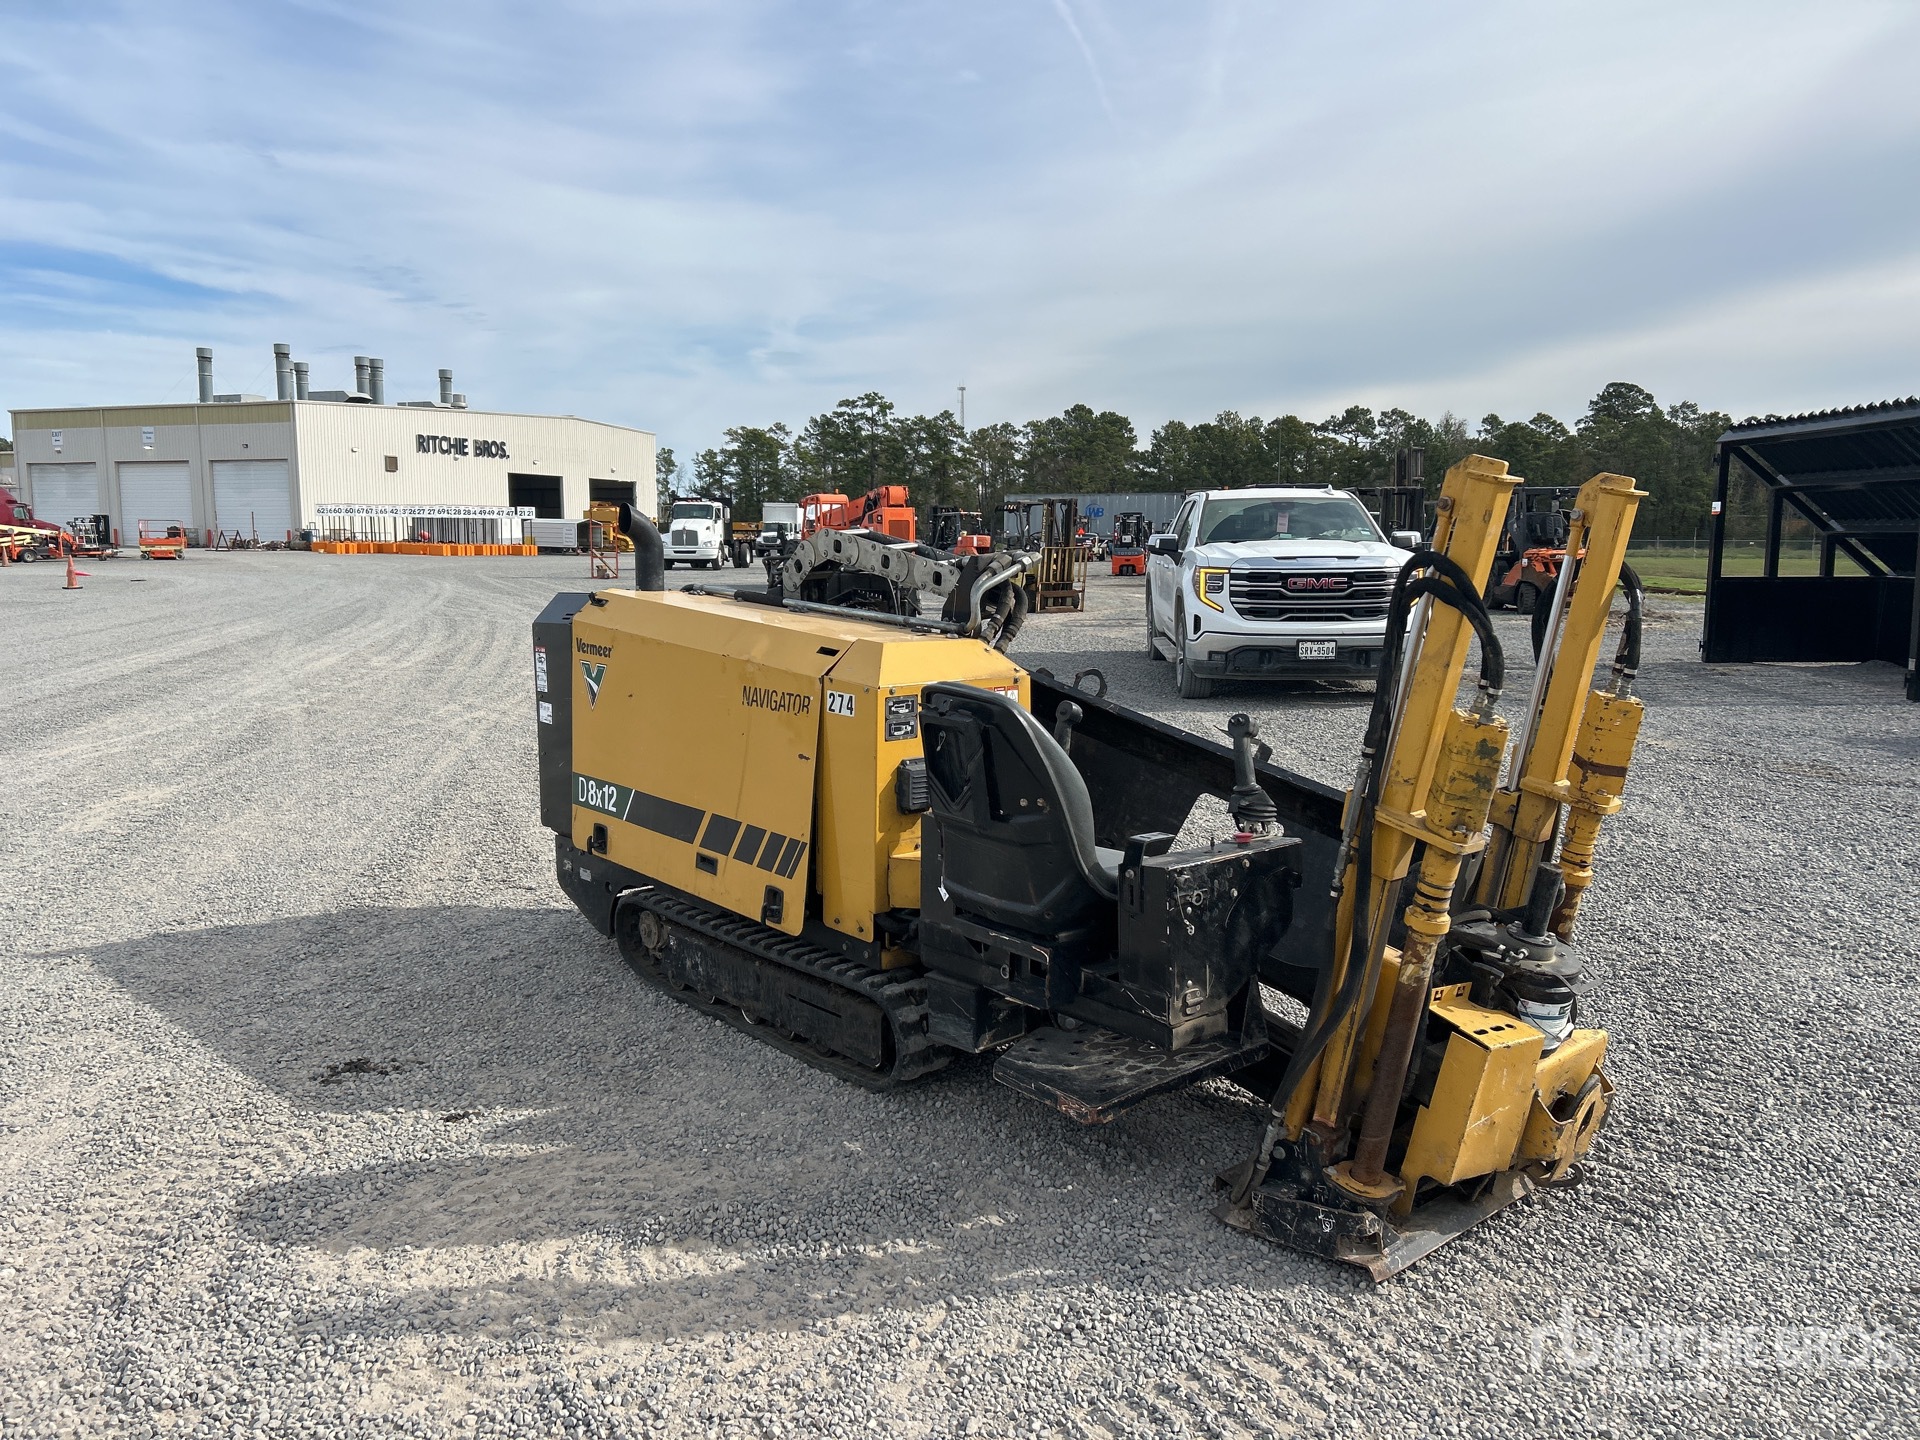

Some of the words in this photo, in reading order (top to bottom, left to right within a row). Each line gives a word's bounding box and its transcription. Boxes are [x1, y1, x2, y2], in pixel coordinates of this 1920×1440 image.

[416, 434, 469, 456] RITCHIE
[473, 439, 510, 460] BROS.
[365, 507, 373, 515] 67
[1287, 577, 1348, 590] GMC
[575, 637, 613, 659] Vermeer
[742, 685, 812, 716] NAVIGATOR
[828, 692, 854, 715] 274
